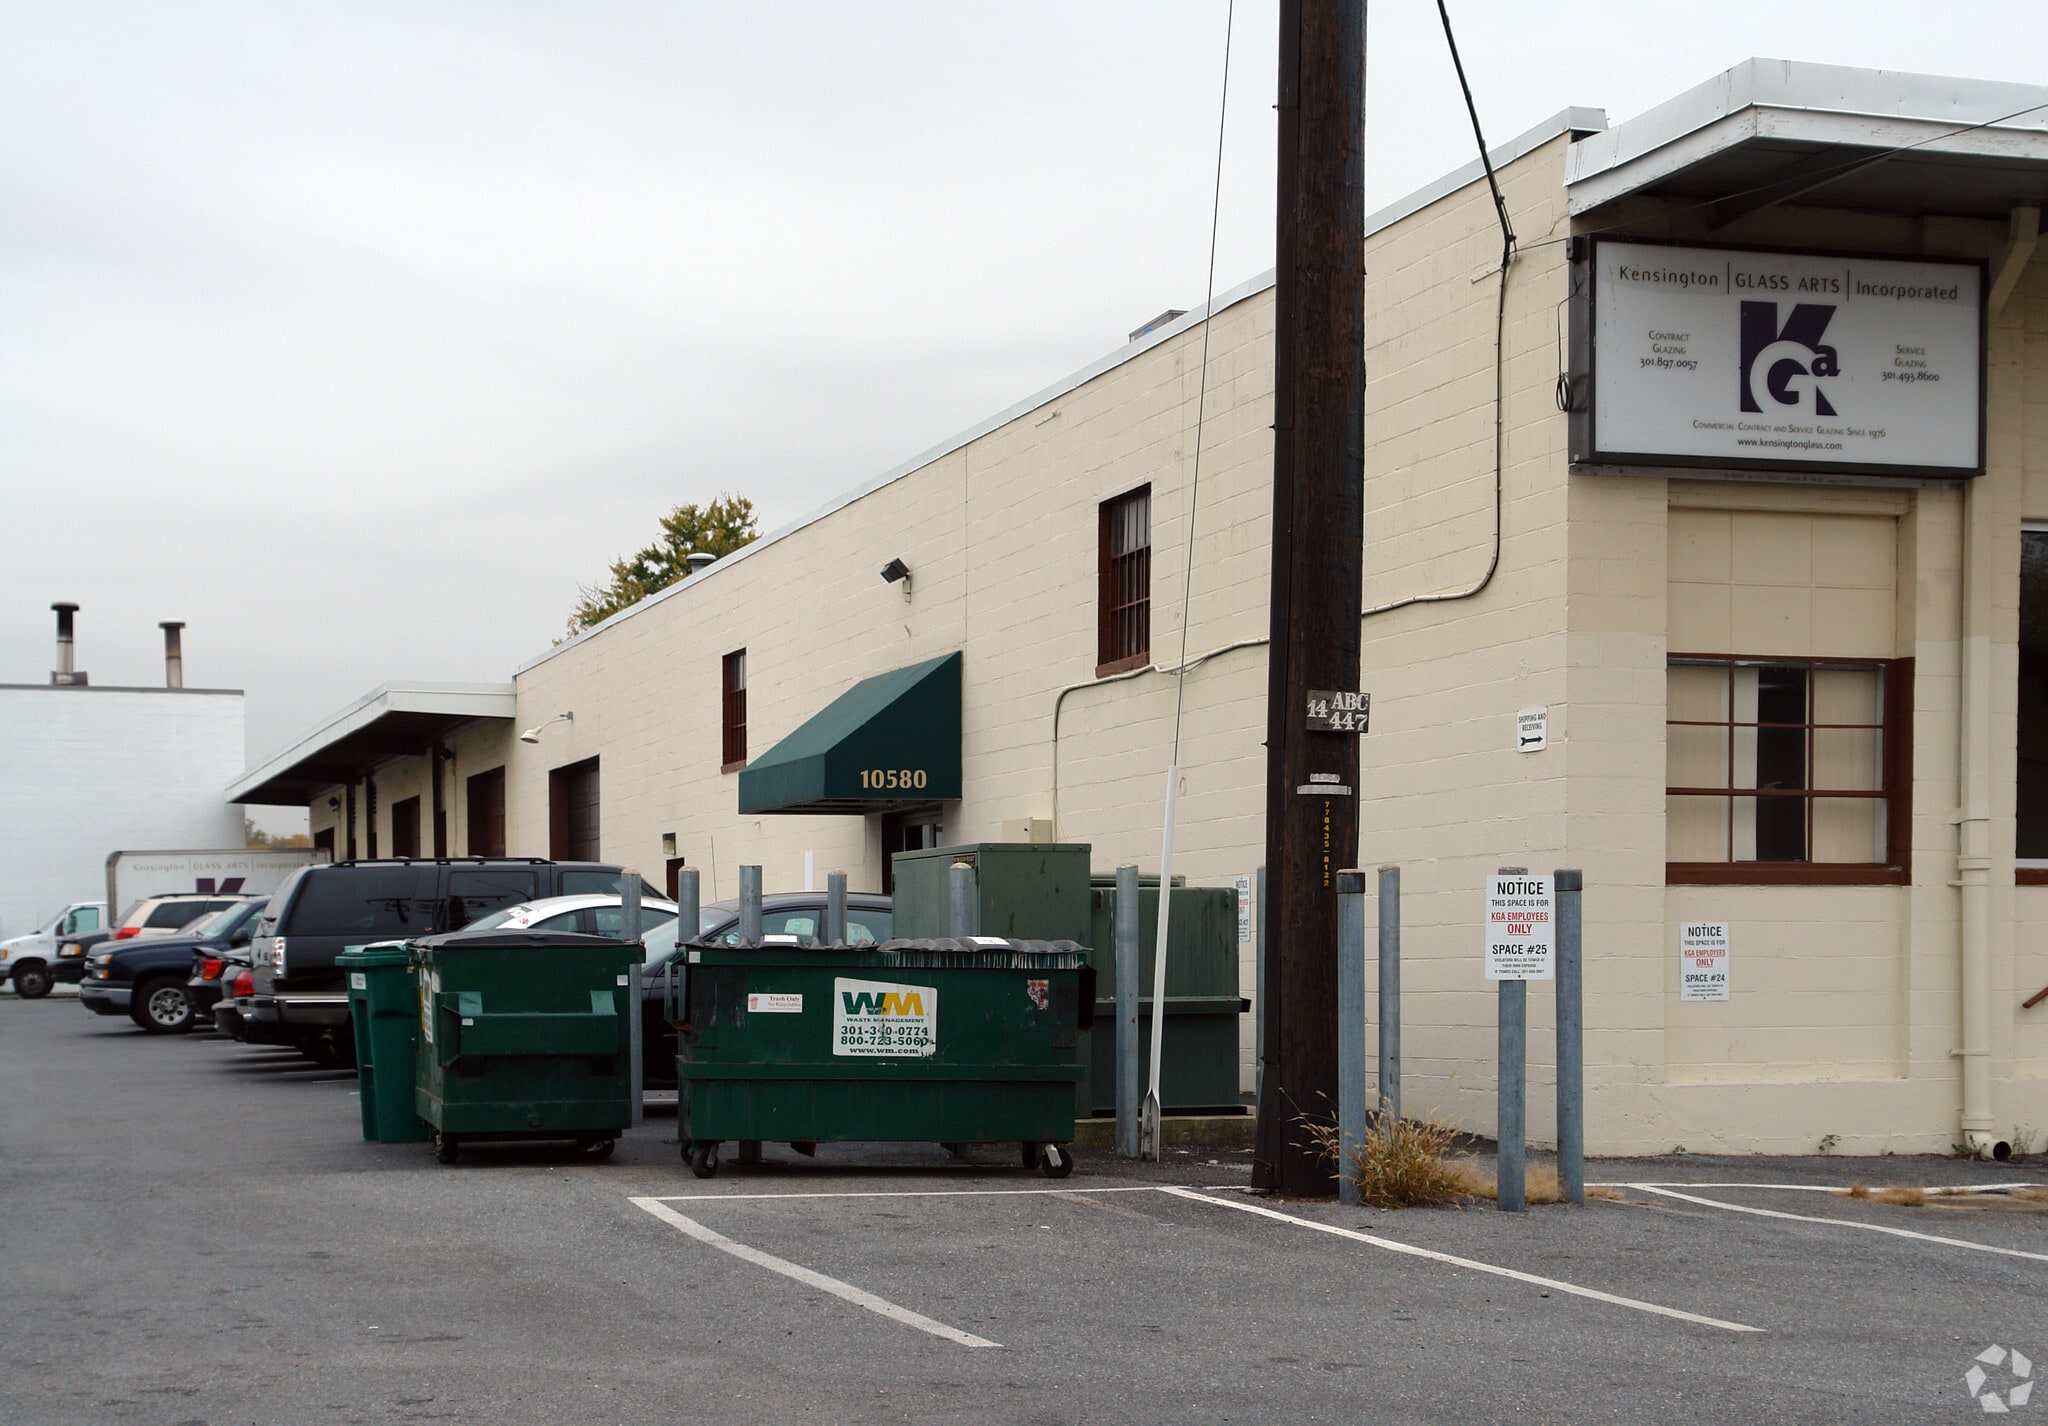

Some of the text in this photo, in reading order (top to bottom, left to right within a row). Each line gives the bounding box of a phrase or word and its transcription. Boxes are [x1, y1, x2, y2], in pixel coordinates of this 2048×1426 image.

[1619, 265, 1959, 301] Kensington GLASS ARTS Incorporated
[1640, 357, 1698, 371] 301.897.0057
[1882, 371, 1940, 383] 301.493.8600
[1868, 428, 1887, 439] 1976
[1737, 437, 1843, 451] www.kensingtonglass.com
[1330, 691, 1369, 711] ABC
[1307, 699, 1328, 718] 14
[1328, 711, 1368, 731] 447
[1518, 712, 1546, 723] SHIPPING AND
[860, 769, 927, 789] 10580
[132, 863, 185, 872] Kensington
[192, 862, 222, 871] GLASS
[226, 861, 249, 870] ARTS
[1497, 881, 1544, 895] NOTICE
[1491, 899, 1549, 907] THIS SPACE IS FOR
[1491, 911, 1549, 921] KGA EMPLOYEES
[1507, 923, 1533, 934] ONLY
[1688, 926, 1722, 937] NOTICE
[1492, 944, 1548, 955] SPACE #25
[1684, 949, 1726, 957] KGA EMPLOYEES
[1695, 958, 1715, 967] ONLY
[1685, 973, 1725, 983] SPACE #24
[841, 991, 925, 1017] WM
[840, 1036, 929, 1046] 800-723-5060
